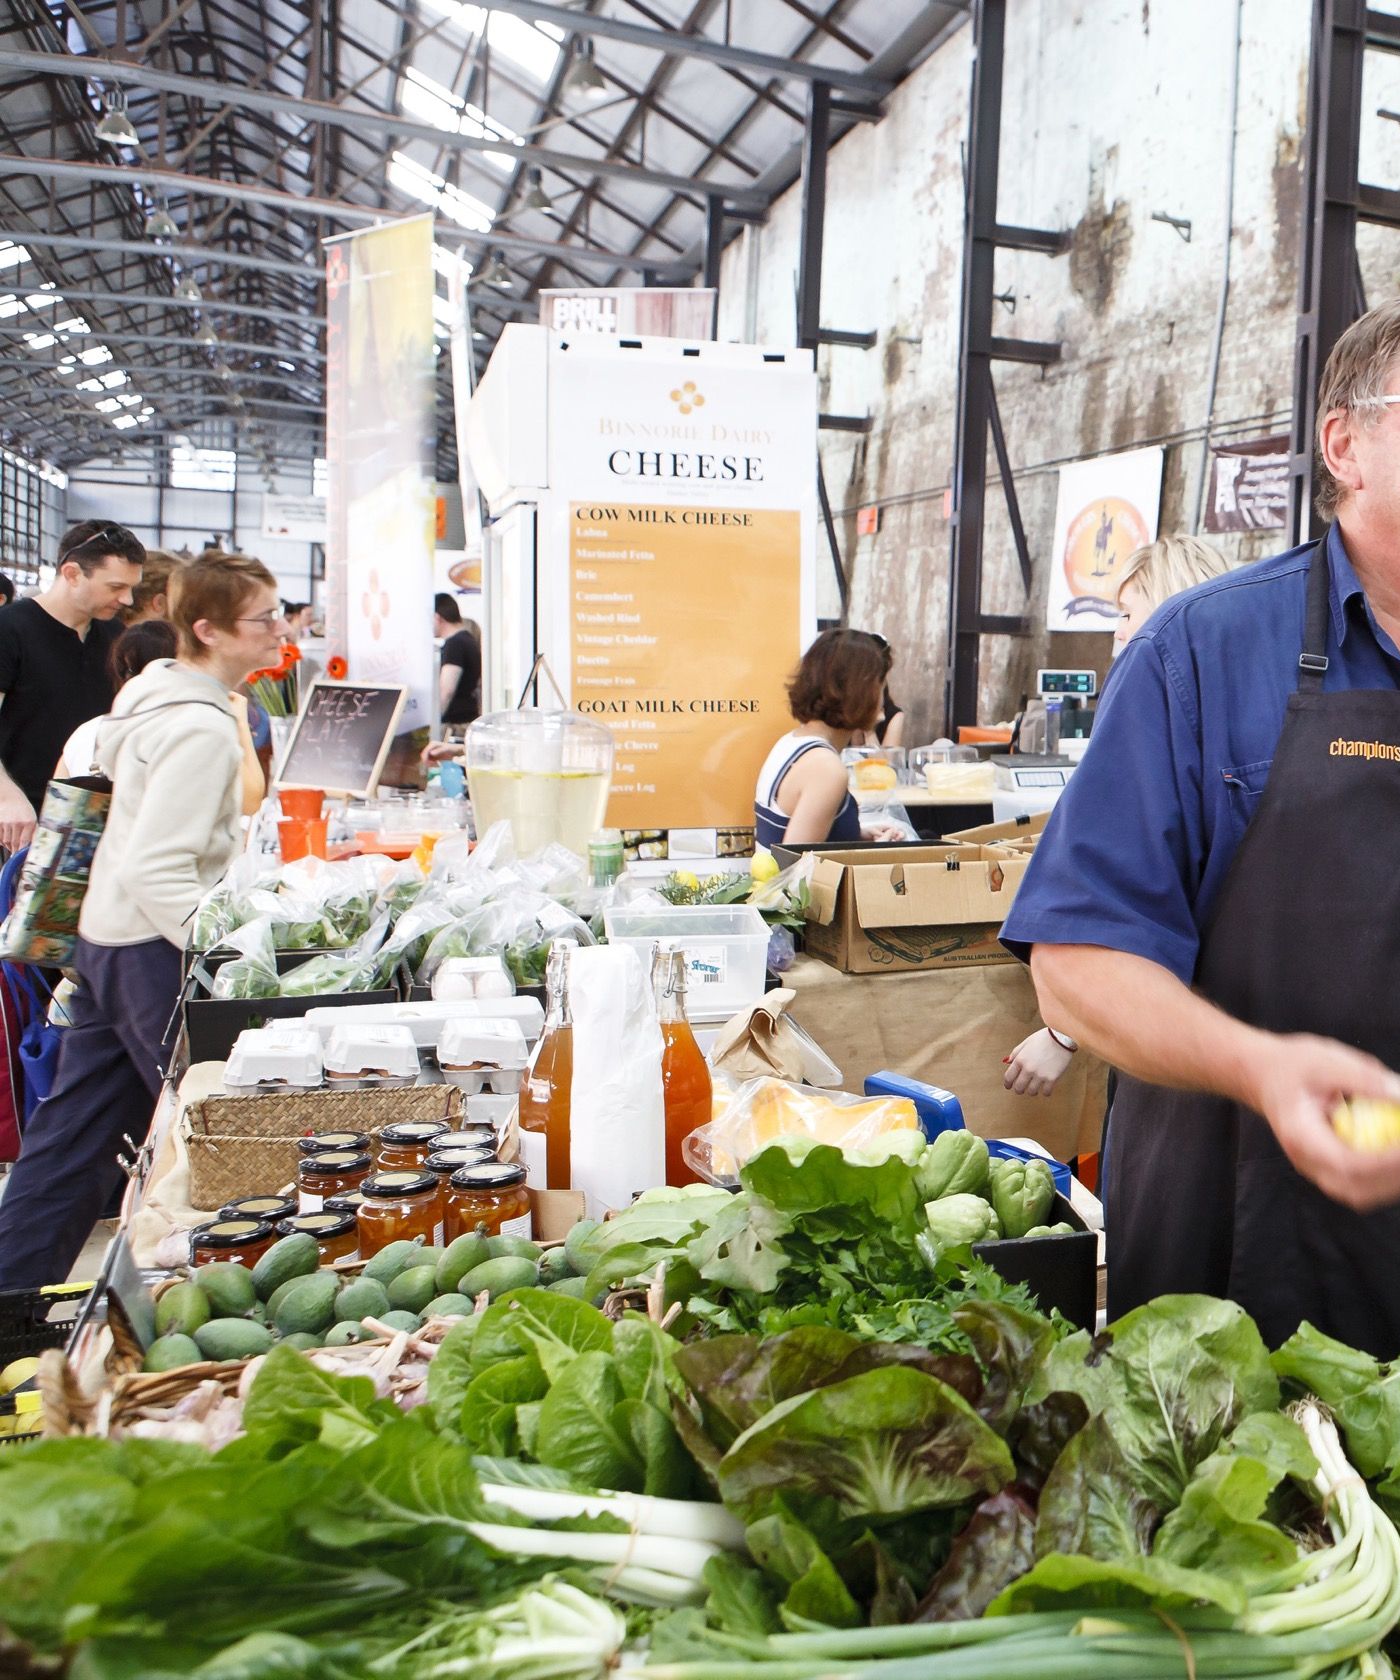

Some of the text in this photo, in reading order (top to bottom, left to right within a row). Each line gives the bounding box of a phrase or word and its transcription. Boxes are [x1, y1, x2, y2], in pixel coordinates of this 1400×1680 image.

[553, 297, 617, 320] BRILL
[712, 424, 775, 445] DAIRY
[608, 449, 765, 482] CHEESE
[576, 506, 754, 527] COW MILK CHEESE
[575, 569, 597, 580] Brie
[575, 591, 633, 601] Camembert
[576, 613, 640, 623] Washed Rind
[615, 634, 657, 645] Cheddar
[577, 700, 760, 713] GOAT MILK CHEESE
[943, 953, 987, 962] AUSTRALIAN
